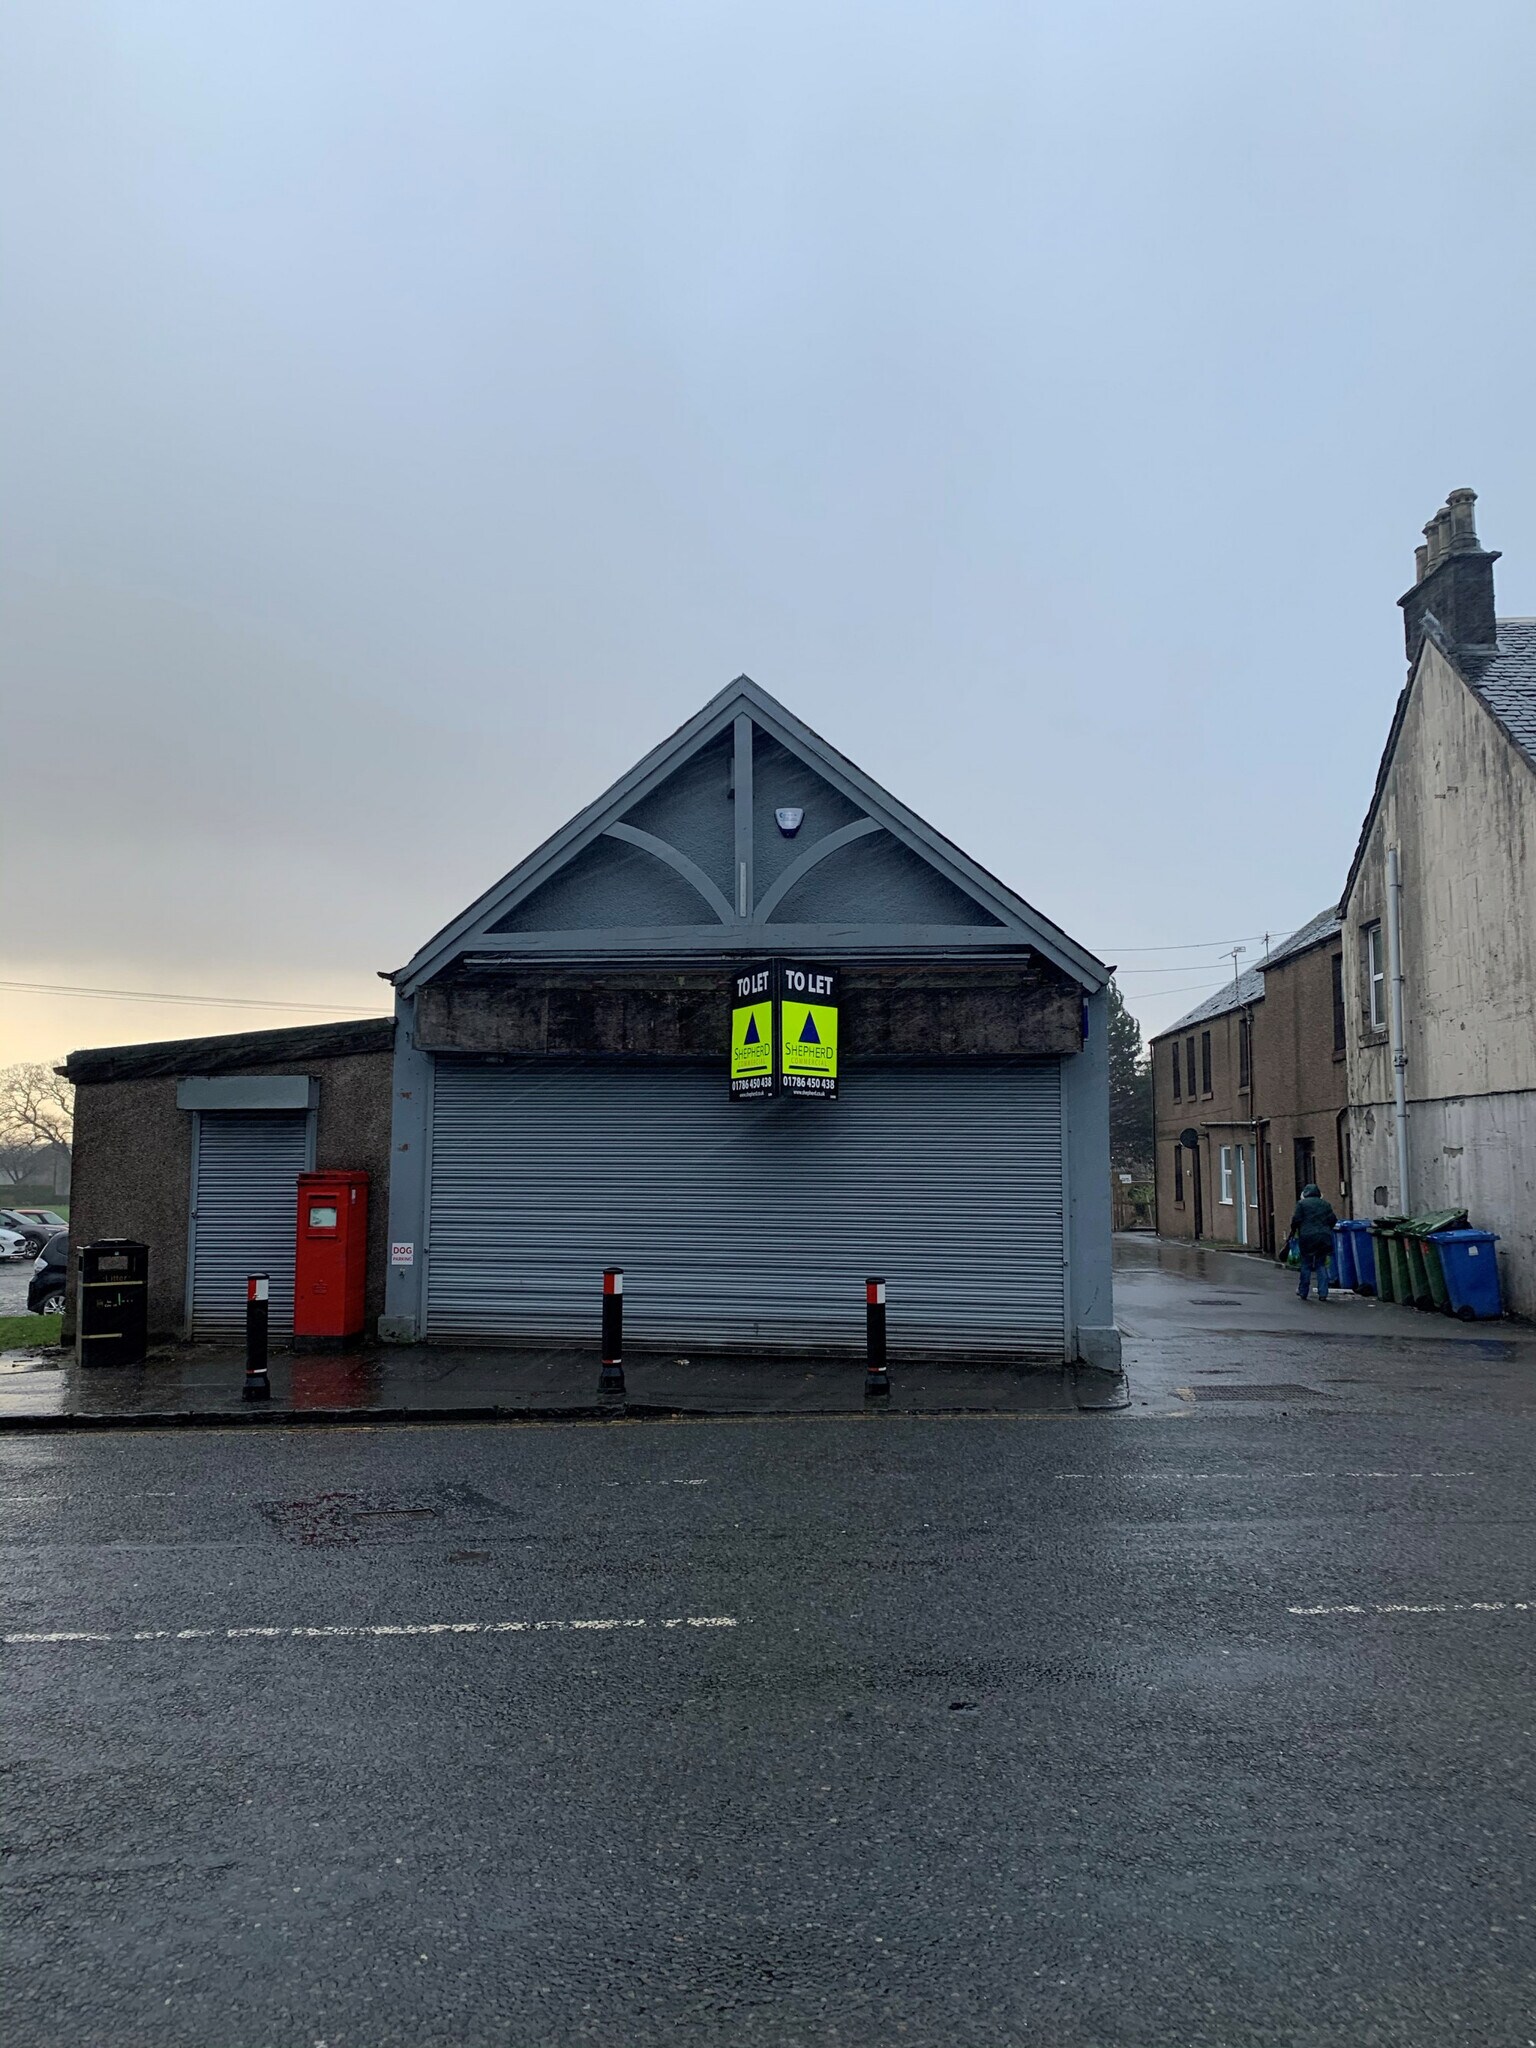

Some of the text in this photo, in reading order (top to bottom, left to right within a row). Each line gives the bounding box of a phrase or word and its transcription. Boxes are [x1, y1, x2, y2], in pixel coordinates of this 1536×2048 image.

[737, 971, 769, 997] TO LET
[785, 969, 833, 995] TO LET
[791, 1057, 827, 1066] COMMERCIAL
[732, 1077, 772, 1091] 01786 450 438
[783, 1076, 835, 1089] 01786 450 438
